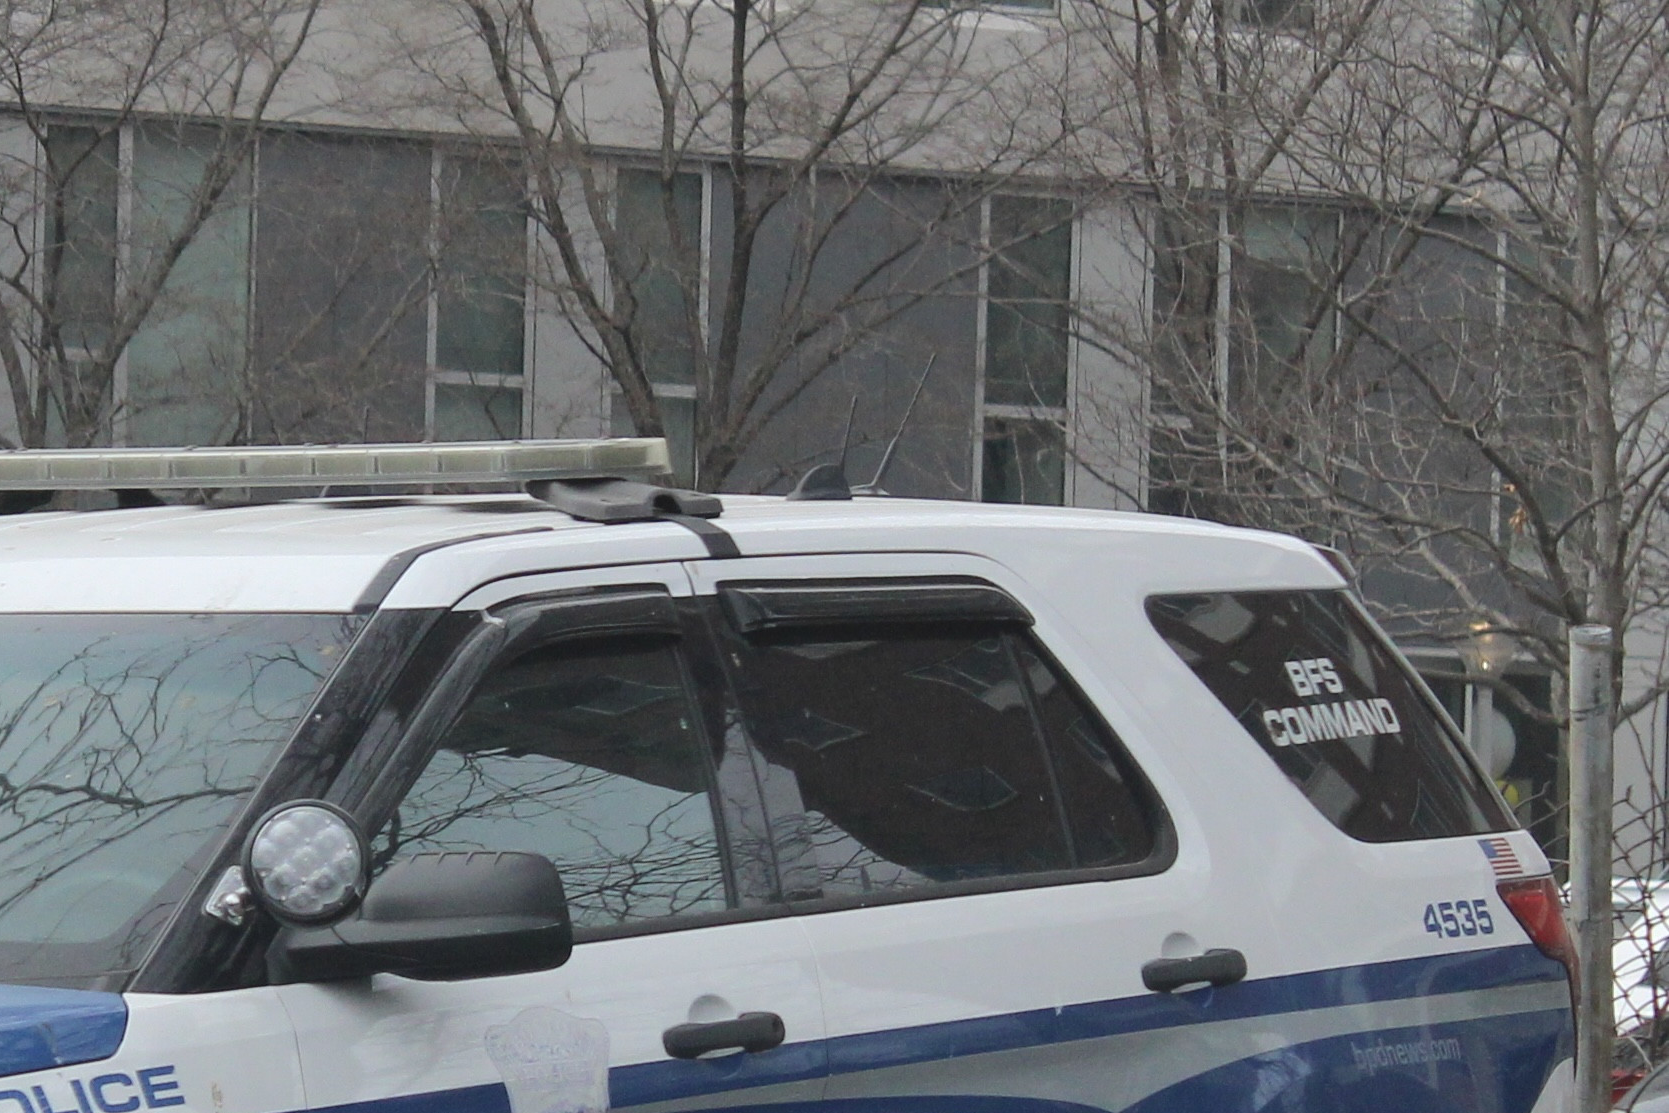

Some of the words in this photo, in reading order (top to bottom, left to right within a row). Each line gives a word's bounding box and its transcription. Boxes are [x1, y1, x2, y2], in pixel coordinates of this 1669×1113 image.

[1284, 658, 1344, 697] BFS
[1263, 698, 1401, 747] COMMAND
[1423, 899, 1494, 939] 4535
[1350, 1037, 1461, 1077] bpdnews.com
